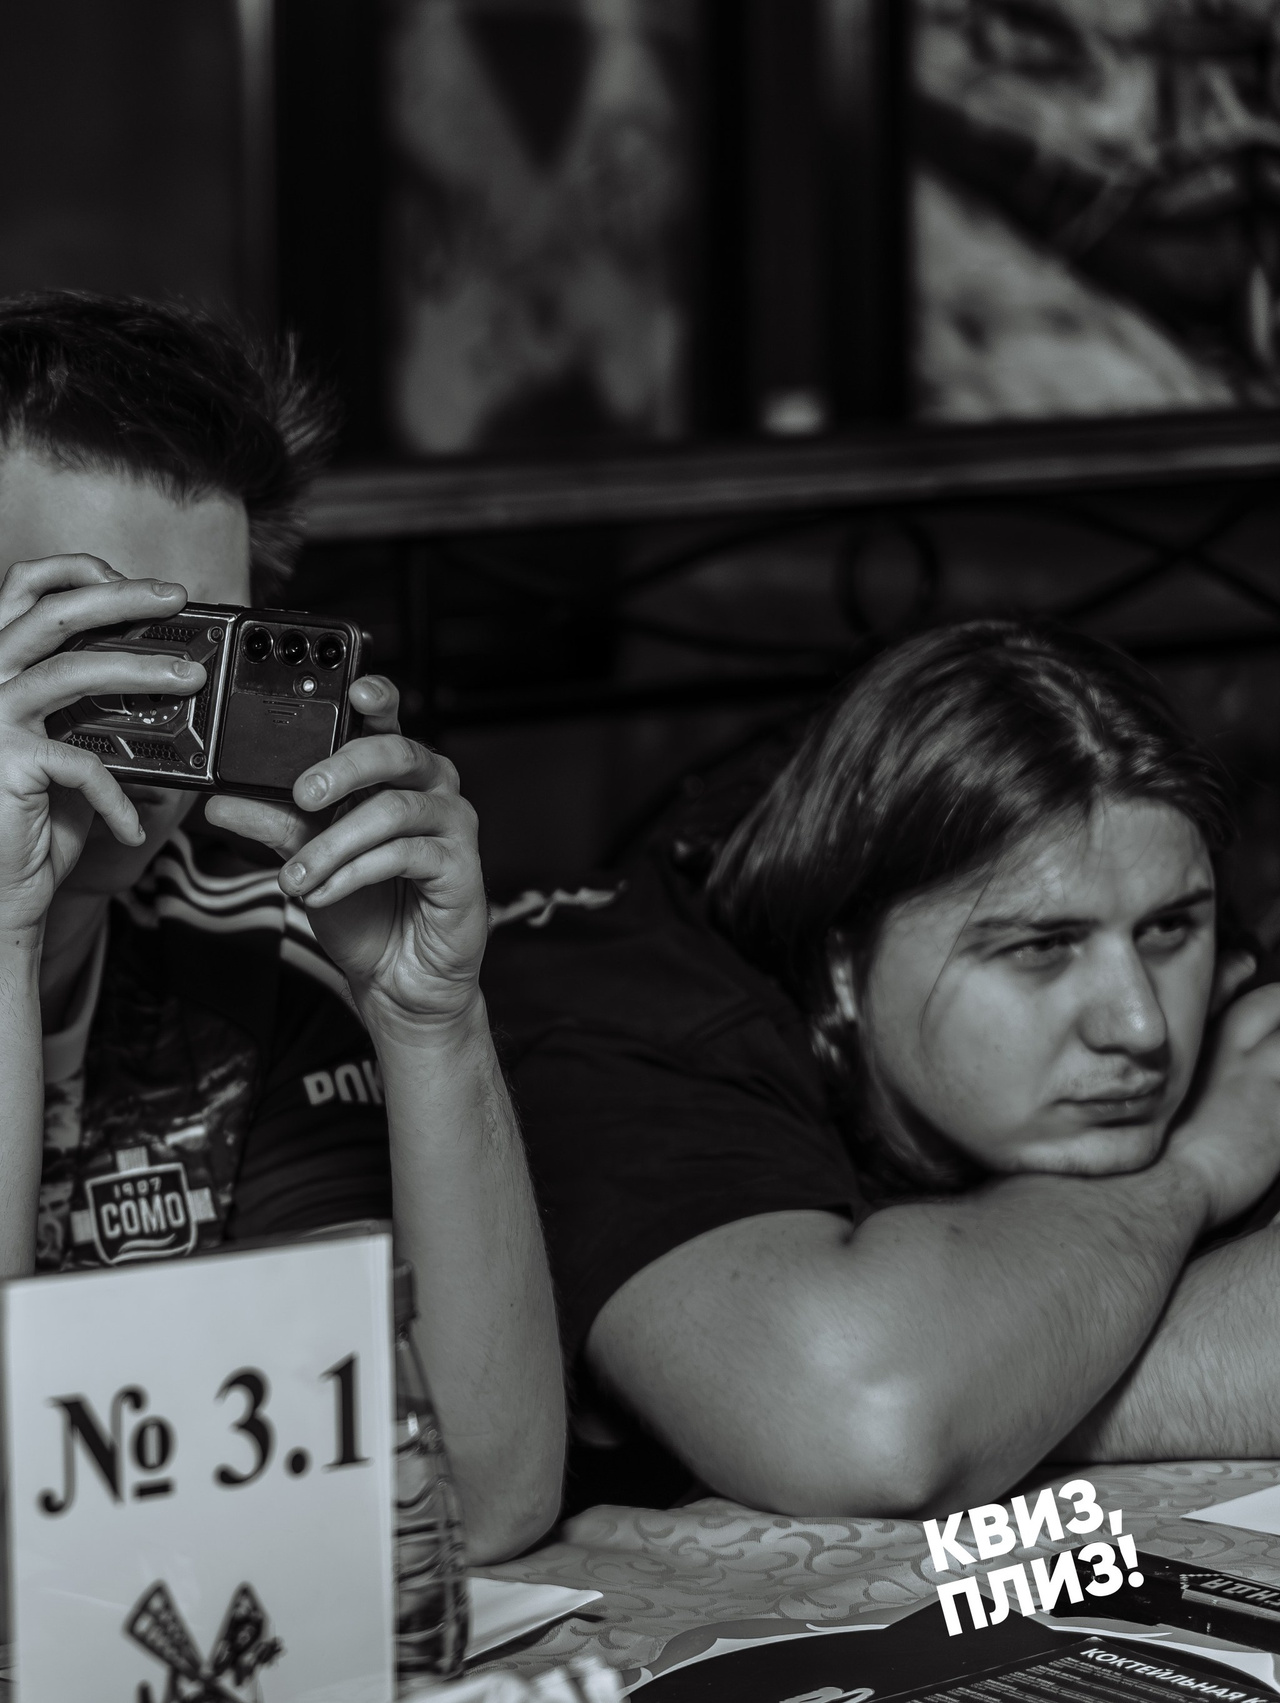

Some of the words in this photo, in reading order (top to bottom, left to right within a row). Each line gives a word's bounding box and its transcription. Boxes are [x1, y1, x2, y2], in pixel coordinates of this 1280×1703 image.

[113, 1176, 163, 1199] 1907
[100, 1191, 186, 1239] COMO
[213, 1350, 374, 1488] 3.1
[1080, 1648, 1247, 1701] КОКТЕЙЛЬНАЯ
